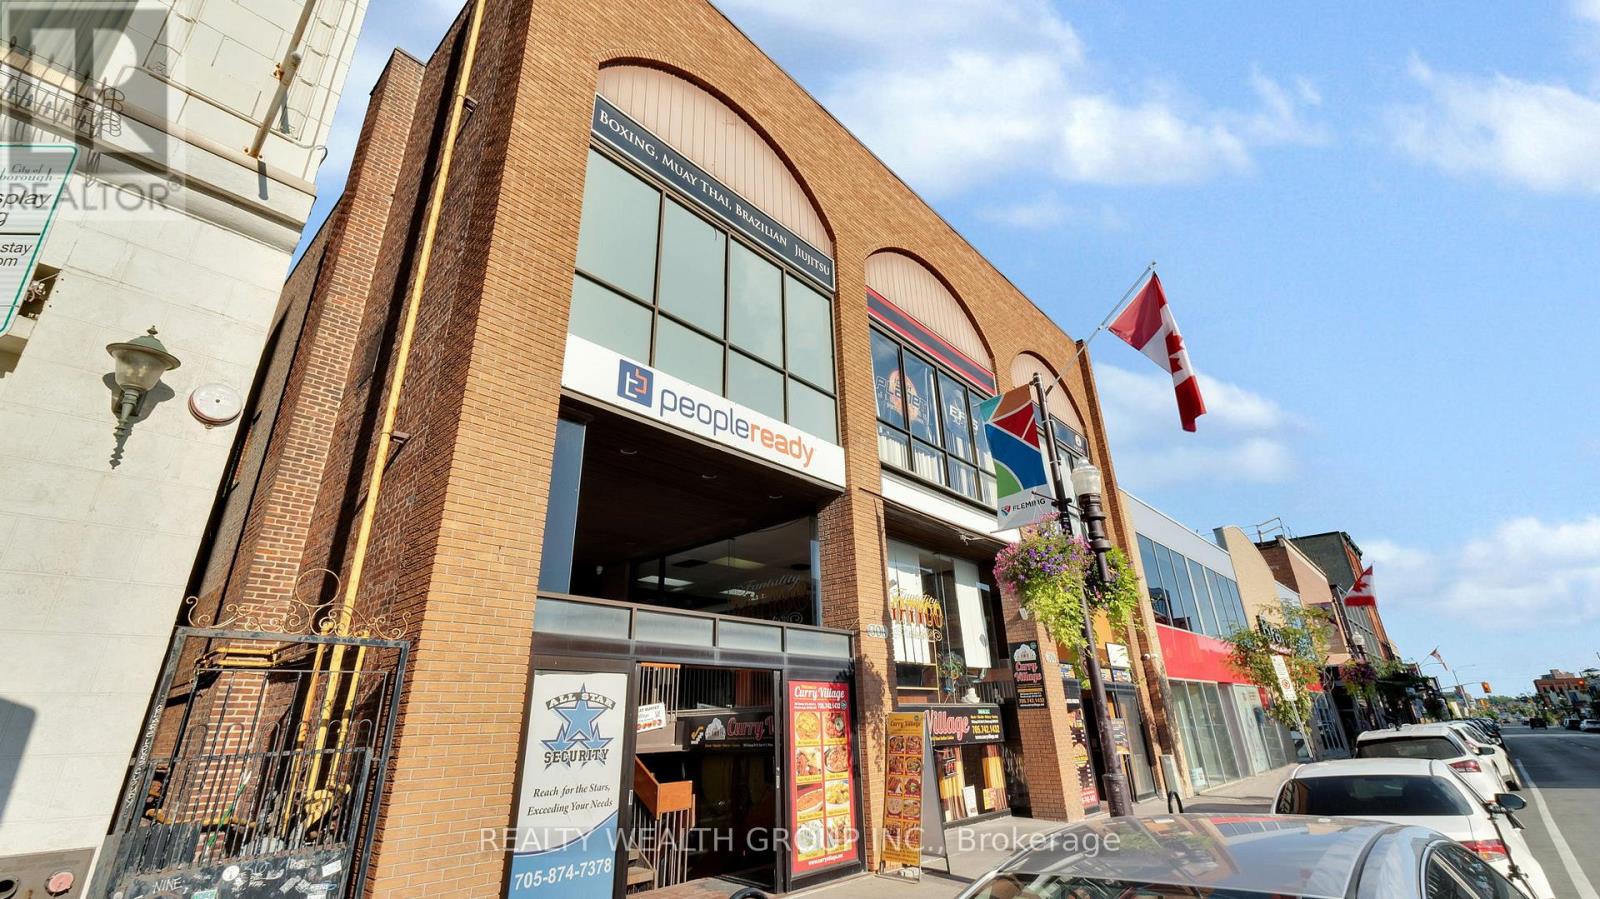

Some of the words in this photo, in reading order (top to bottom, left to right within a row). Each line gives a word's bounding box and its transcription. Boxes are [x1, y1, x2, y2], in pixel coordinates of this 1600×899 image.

[660, 388, 815, 467] peopleready
[1015, 662, 1038, 672] Curry
[1014, 672, 1042, 683] Village
[549, 693, 576, 708] ALL
[581, 692, 613, 708] STAR
[794, 686, 817, 701] Curry
[817, 688, 845, 701] Village
[727, 717, 764, 741] Curry
[925, 709, 970, 741] Village
[544, 749, 609, 764] SECURITY
[533, 786, 558, 798] Reach
[560, 785, 574, 798] for
[575, 784, 587, 793] the
[589, 782, 611, 792] Stars,
[527, 803, 569, 816] Exceeding
[571, 801, 590, 811] Your
[591, 798, 613, 809] Needs
[515, 858, 612, 890] 705-874-7378
